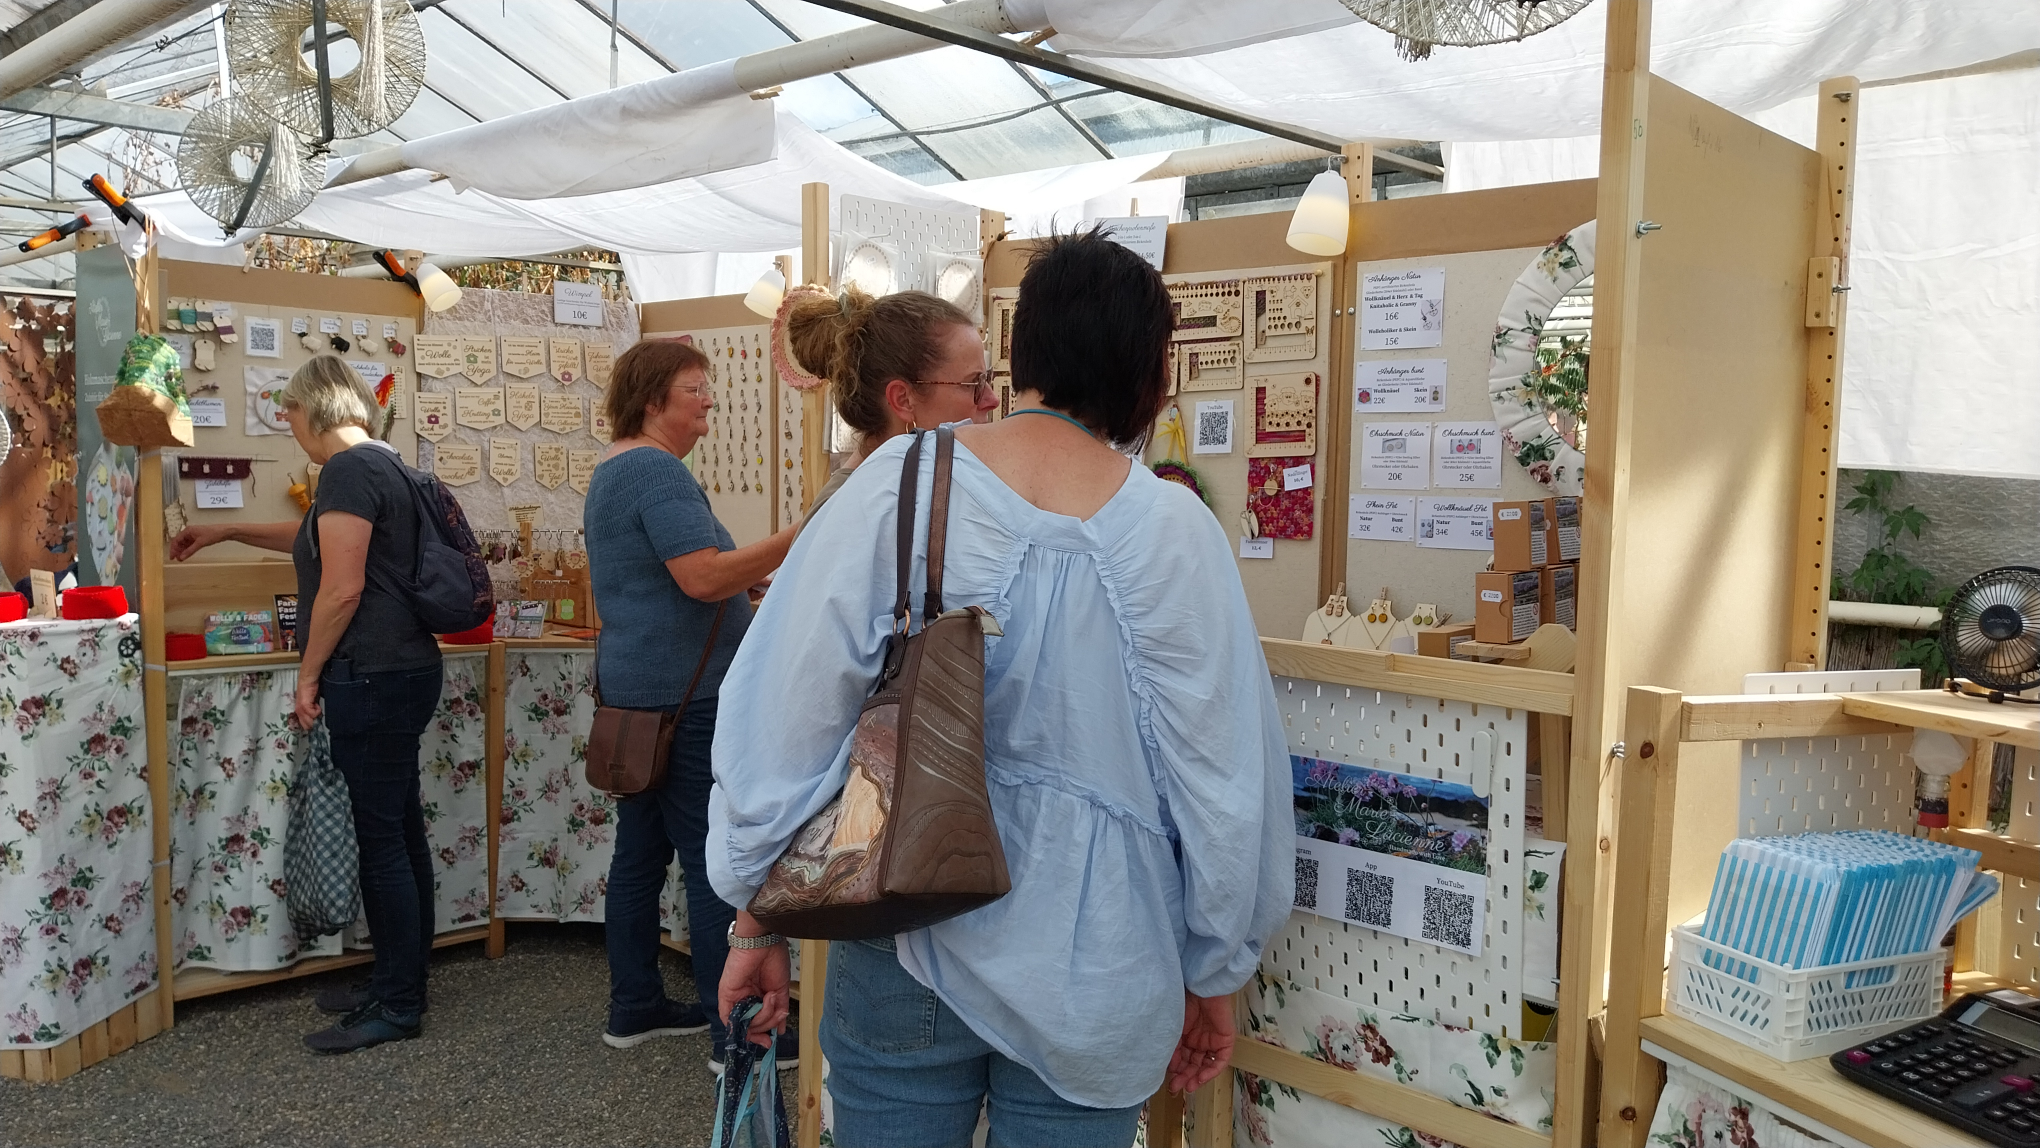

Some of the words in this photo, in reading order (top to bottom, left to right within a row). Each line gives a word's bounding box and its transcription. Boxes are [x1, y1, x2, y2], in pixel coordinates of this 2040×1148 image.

[573, 310, 587, 319] 10€
[1385, 312, 1399, 320] 16€
[1385, 337, 1399, 346] 15€
[1414, 396, 1427, 404] 20€
[193, 415, 211, 424] 20€
[1388, 472, 1402, 481] 20€
[1459, 473, 1474, 482] 25€
[210, 496, 228, 505] 29€
[1358, 524, 1371, 532] 32€
[1391, 526, 1403, 534] 42€
[1435, 528, 1449, 536] 34€
[1470, 529, 1484, 537] 45€
[1305, 772, 1363, 794] Atelier
[1365, 862, 1378, 871] App
[1436, 878, 1465, 890] YouTube
